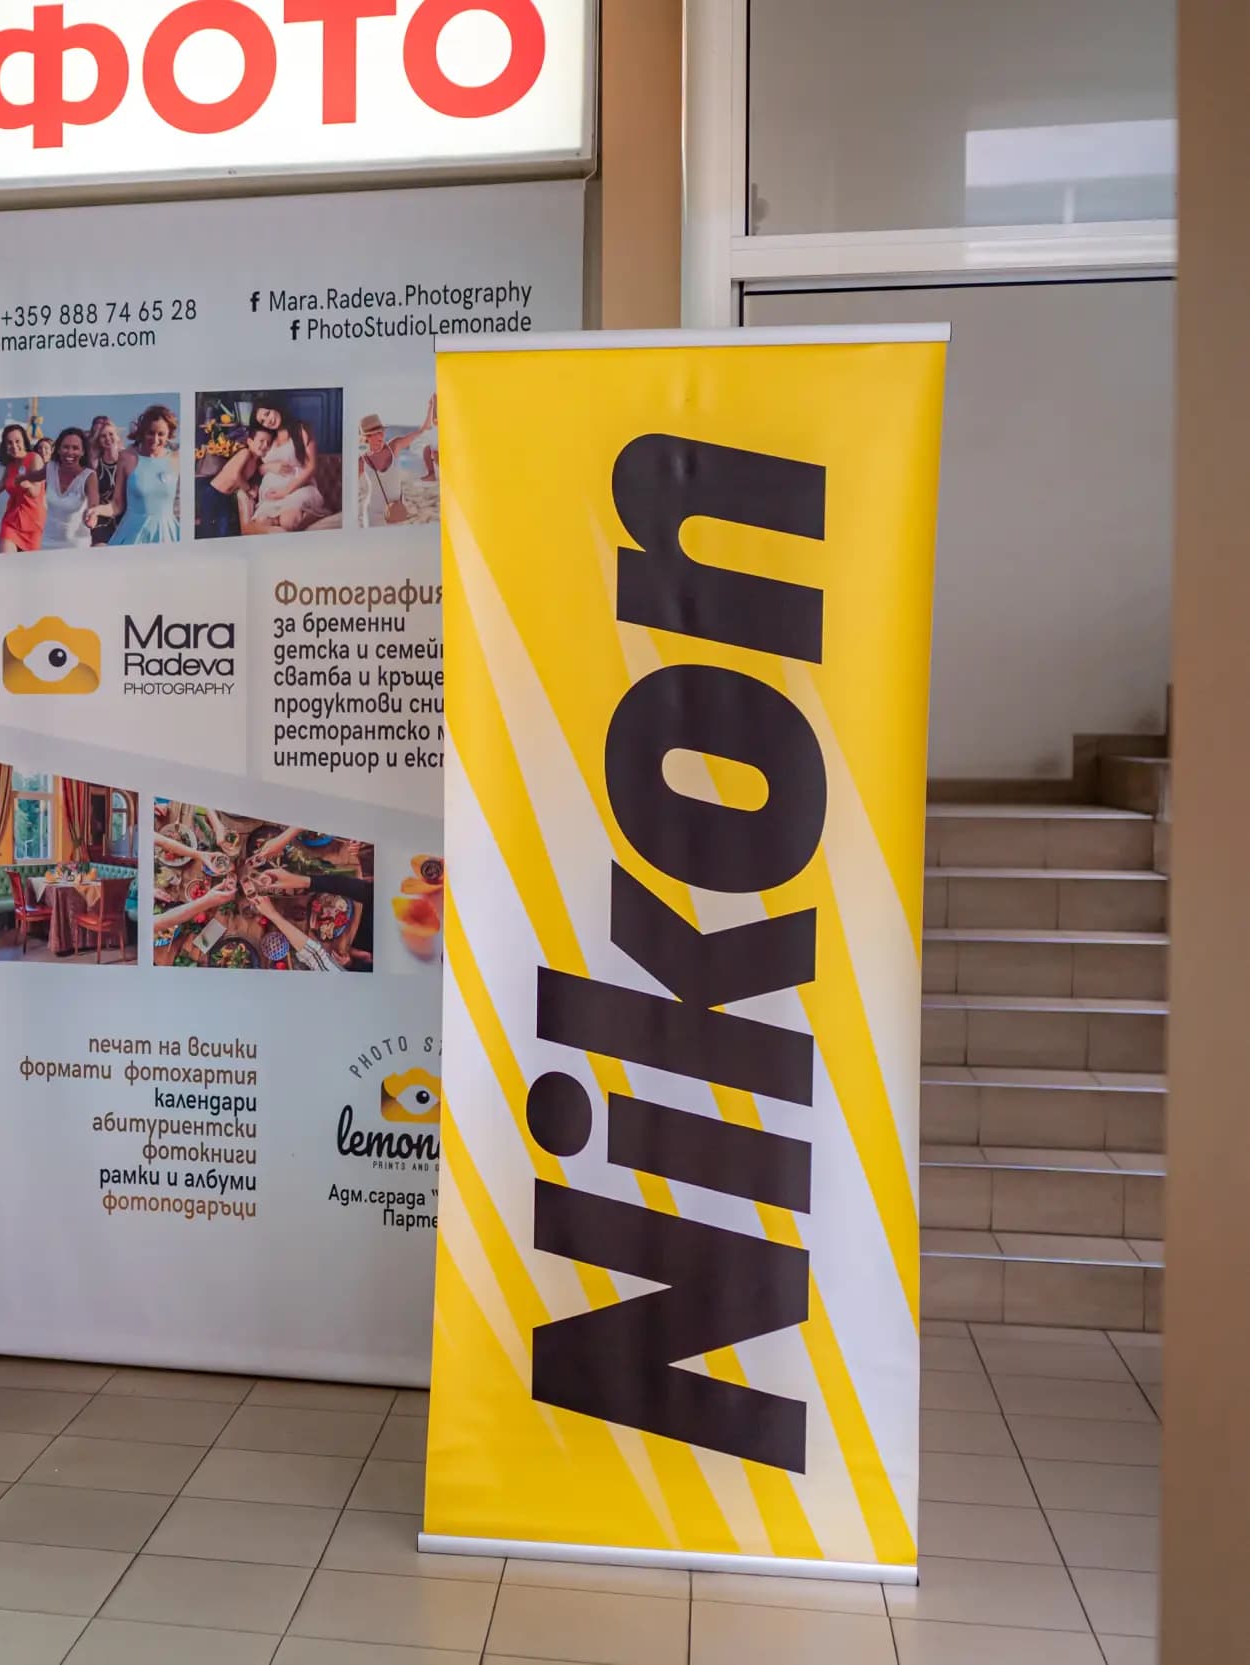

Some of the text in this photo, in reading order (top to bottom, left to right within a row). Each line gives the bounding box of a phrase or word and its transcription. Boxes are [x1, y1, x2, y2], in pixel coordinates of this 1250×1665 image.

[269, 280, 532, 312] Mara.Radeva.Photography
[1, 299, 197, 327] +359 888 74 65 28
[307, 311, 532, 340] PhotoStudioLemonade
[1, 328, 156, 351] mararadeva.com
[124, 614, 235, 649] Mara
[273, 612, 406, 638] за бременни
[124, 652, 235, 676] Radeva
[274, 639, 350, 665] детска
[357, 643, 368, 659] и
[124, 682, 235, 695] PHOTOGRAPHY
[274, 665, 351, 686] сватба
[359, 670, 370, 686] и
[274, 692, 402, 718] продуктови
[274, 719, 430, 746] ресторантско
[273, 750, 379, 773] интериор
[386, 751, 397, 767] и
[526, 433, 828, 1475] Nikon
[89, 1036, 257, 1059] печат на всички
[349, 1035, 408, 1079] PHOTO
[19, 1055, 257, 1089] формати фотохартия
[154, 1087, 257, 1116] календари
[92, 1112, 257, 1139] абитуриентски
[142, 1138, 257, 1165] фотокниги
[100, 1164, 257, 1195] рамки и албуми
[372, 1160, 406, 1171] PRINTS
[412, 1162, 429, 1172] AND
[102, 1190, 257, 1221] фотоподаръци
[328, 1183, 425, 1210] Адм.сграда
